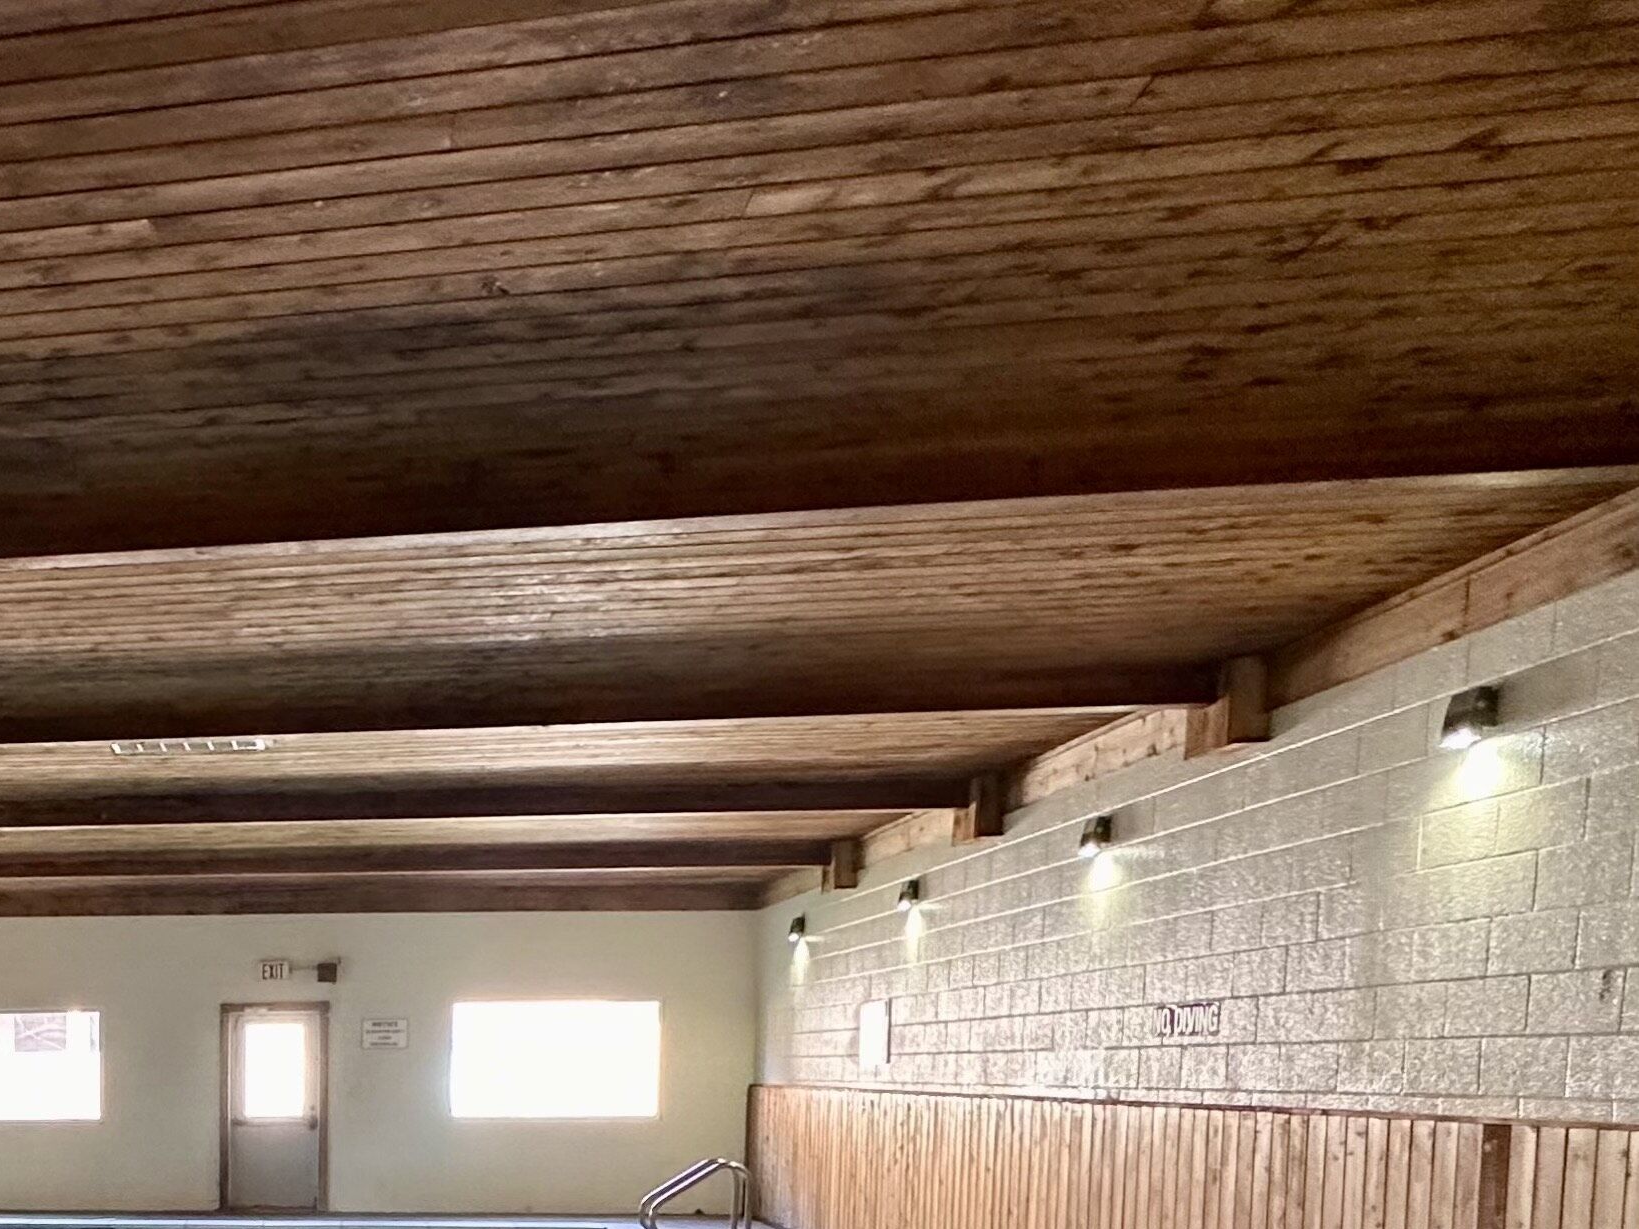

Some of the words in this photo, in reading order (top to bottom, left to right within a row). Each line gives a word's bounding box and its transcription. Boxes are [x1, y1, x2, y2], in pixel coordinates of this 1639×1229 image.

[262, 963, 284, 980] EXIT
[1153, 1008, 1172, 1037] NO
[1174, 1004, 1219, 1037] DIVING
